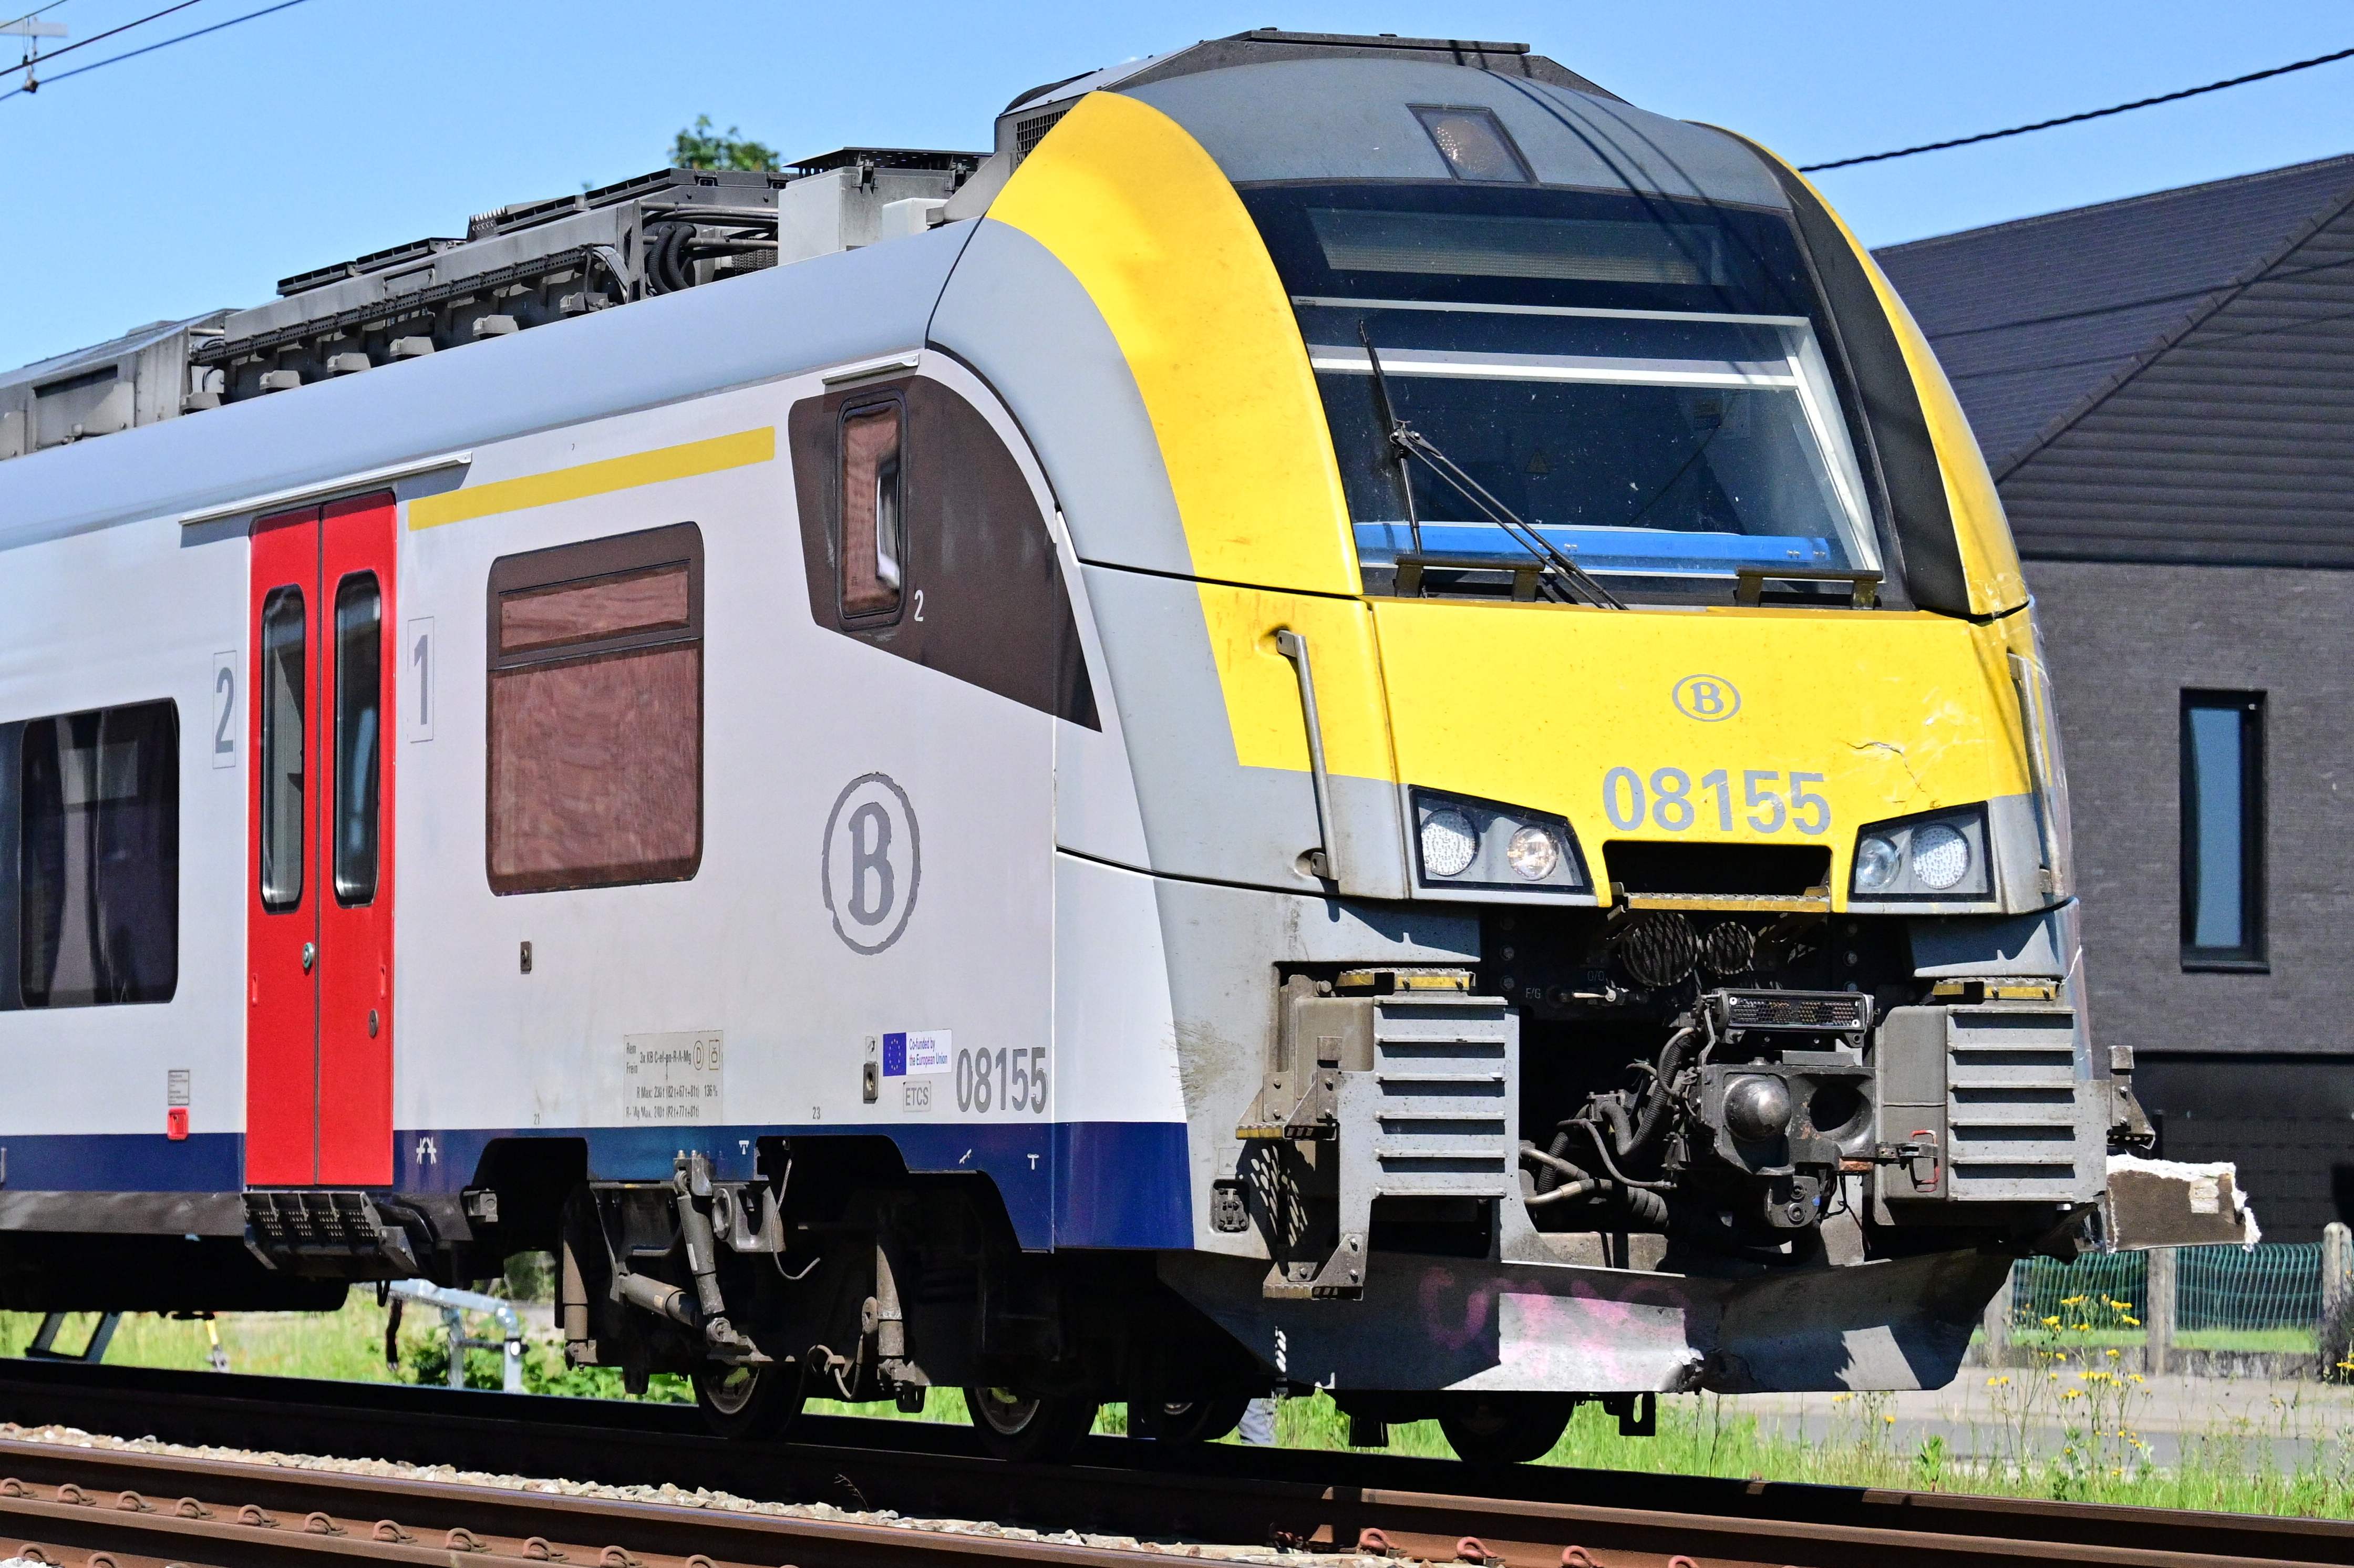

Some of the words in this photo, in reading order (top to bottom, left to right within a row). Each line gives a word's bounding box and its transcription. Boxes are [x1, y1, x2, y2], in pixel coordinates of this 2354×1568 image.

[914, 590, 923, 622] 2
[414, 634, 428, 725] 1
[215, 667, 234, 754] 2
[1603, 766, 1831, 835] 08155
[1525, 987, 1541, 999] F/G
[626, 1043, 636, 1054] Rem
[909, 1037, 929, 1050] Co-funded
[930, 1036, 935, 1052] by
[916, 1054, 935, 1068] European
[936, 1052, 947, 1065] Union
[956, 1047, 1048, 1113] 08155
[905, 1087, 929, 1106] ETCS
[533, 1113, 540, 1125] 21
[812, 1106, 821, 1119] 23
